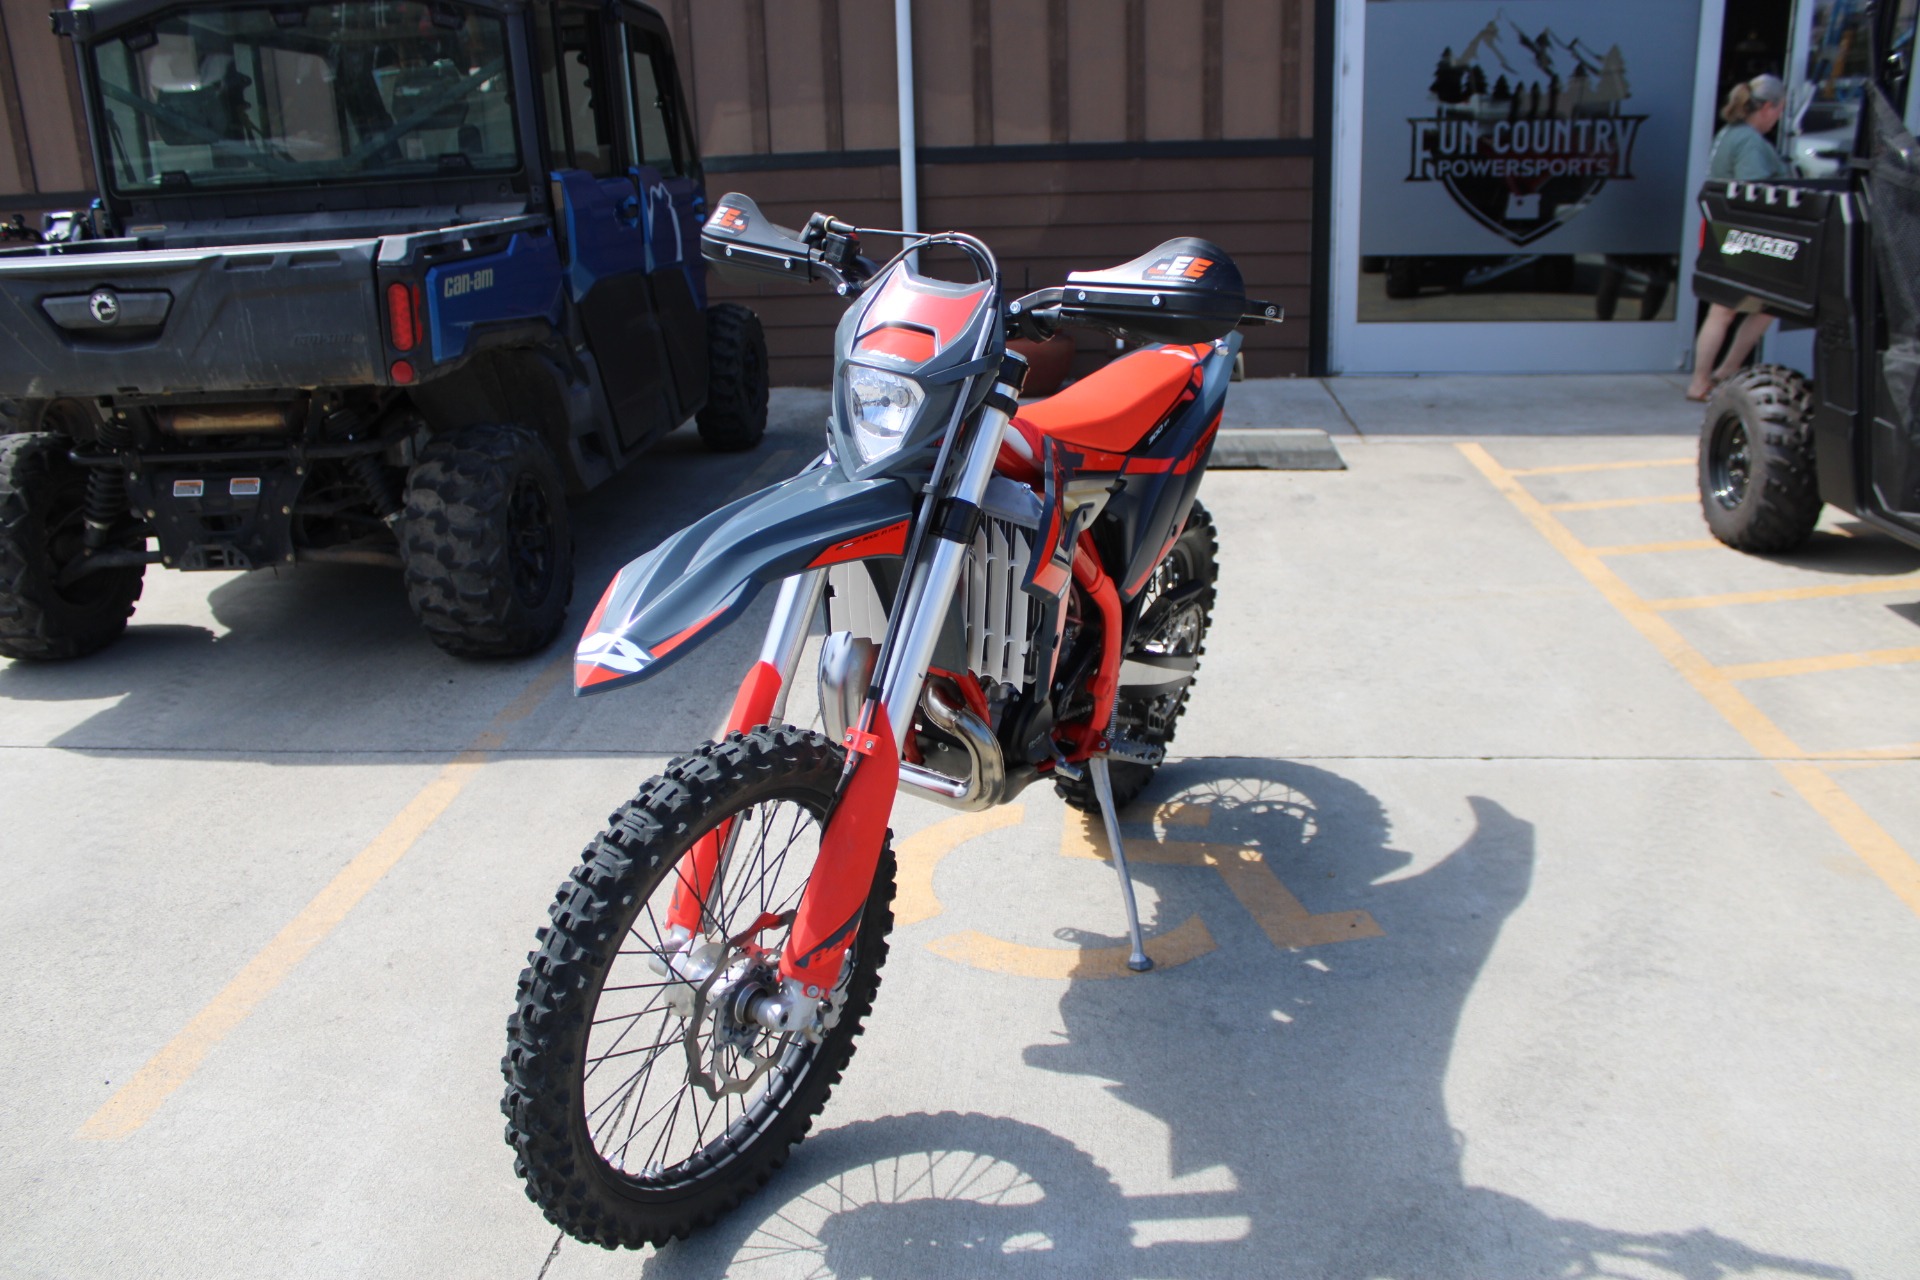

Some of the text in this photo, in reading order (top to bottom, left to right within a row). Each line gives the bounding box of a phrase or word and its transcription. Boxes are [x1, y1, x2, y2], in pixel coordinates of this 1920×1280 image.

[1407, 116, 1645, 180] FUN COUNTRY
[1437, 157, 1610, 177] POWERSPORTS
[444, 267, 493, 298] can-am
